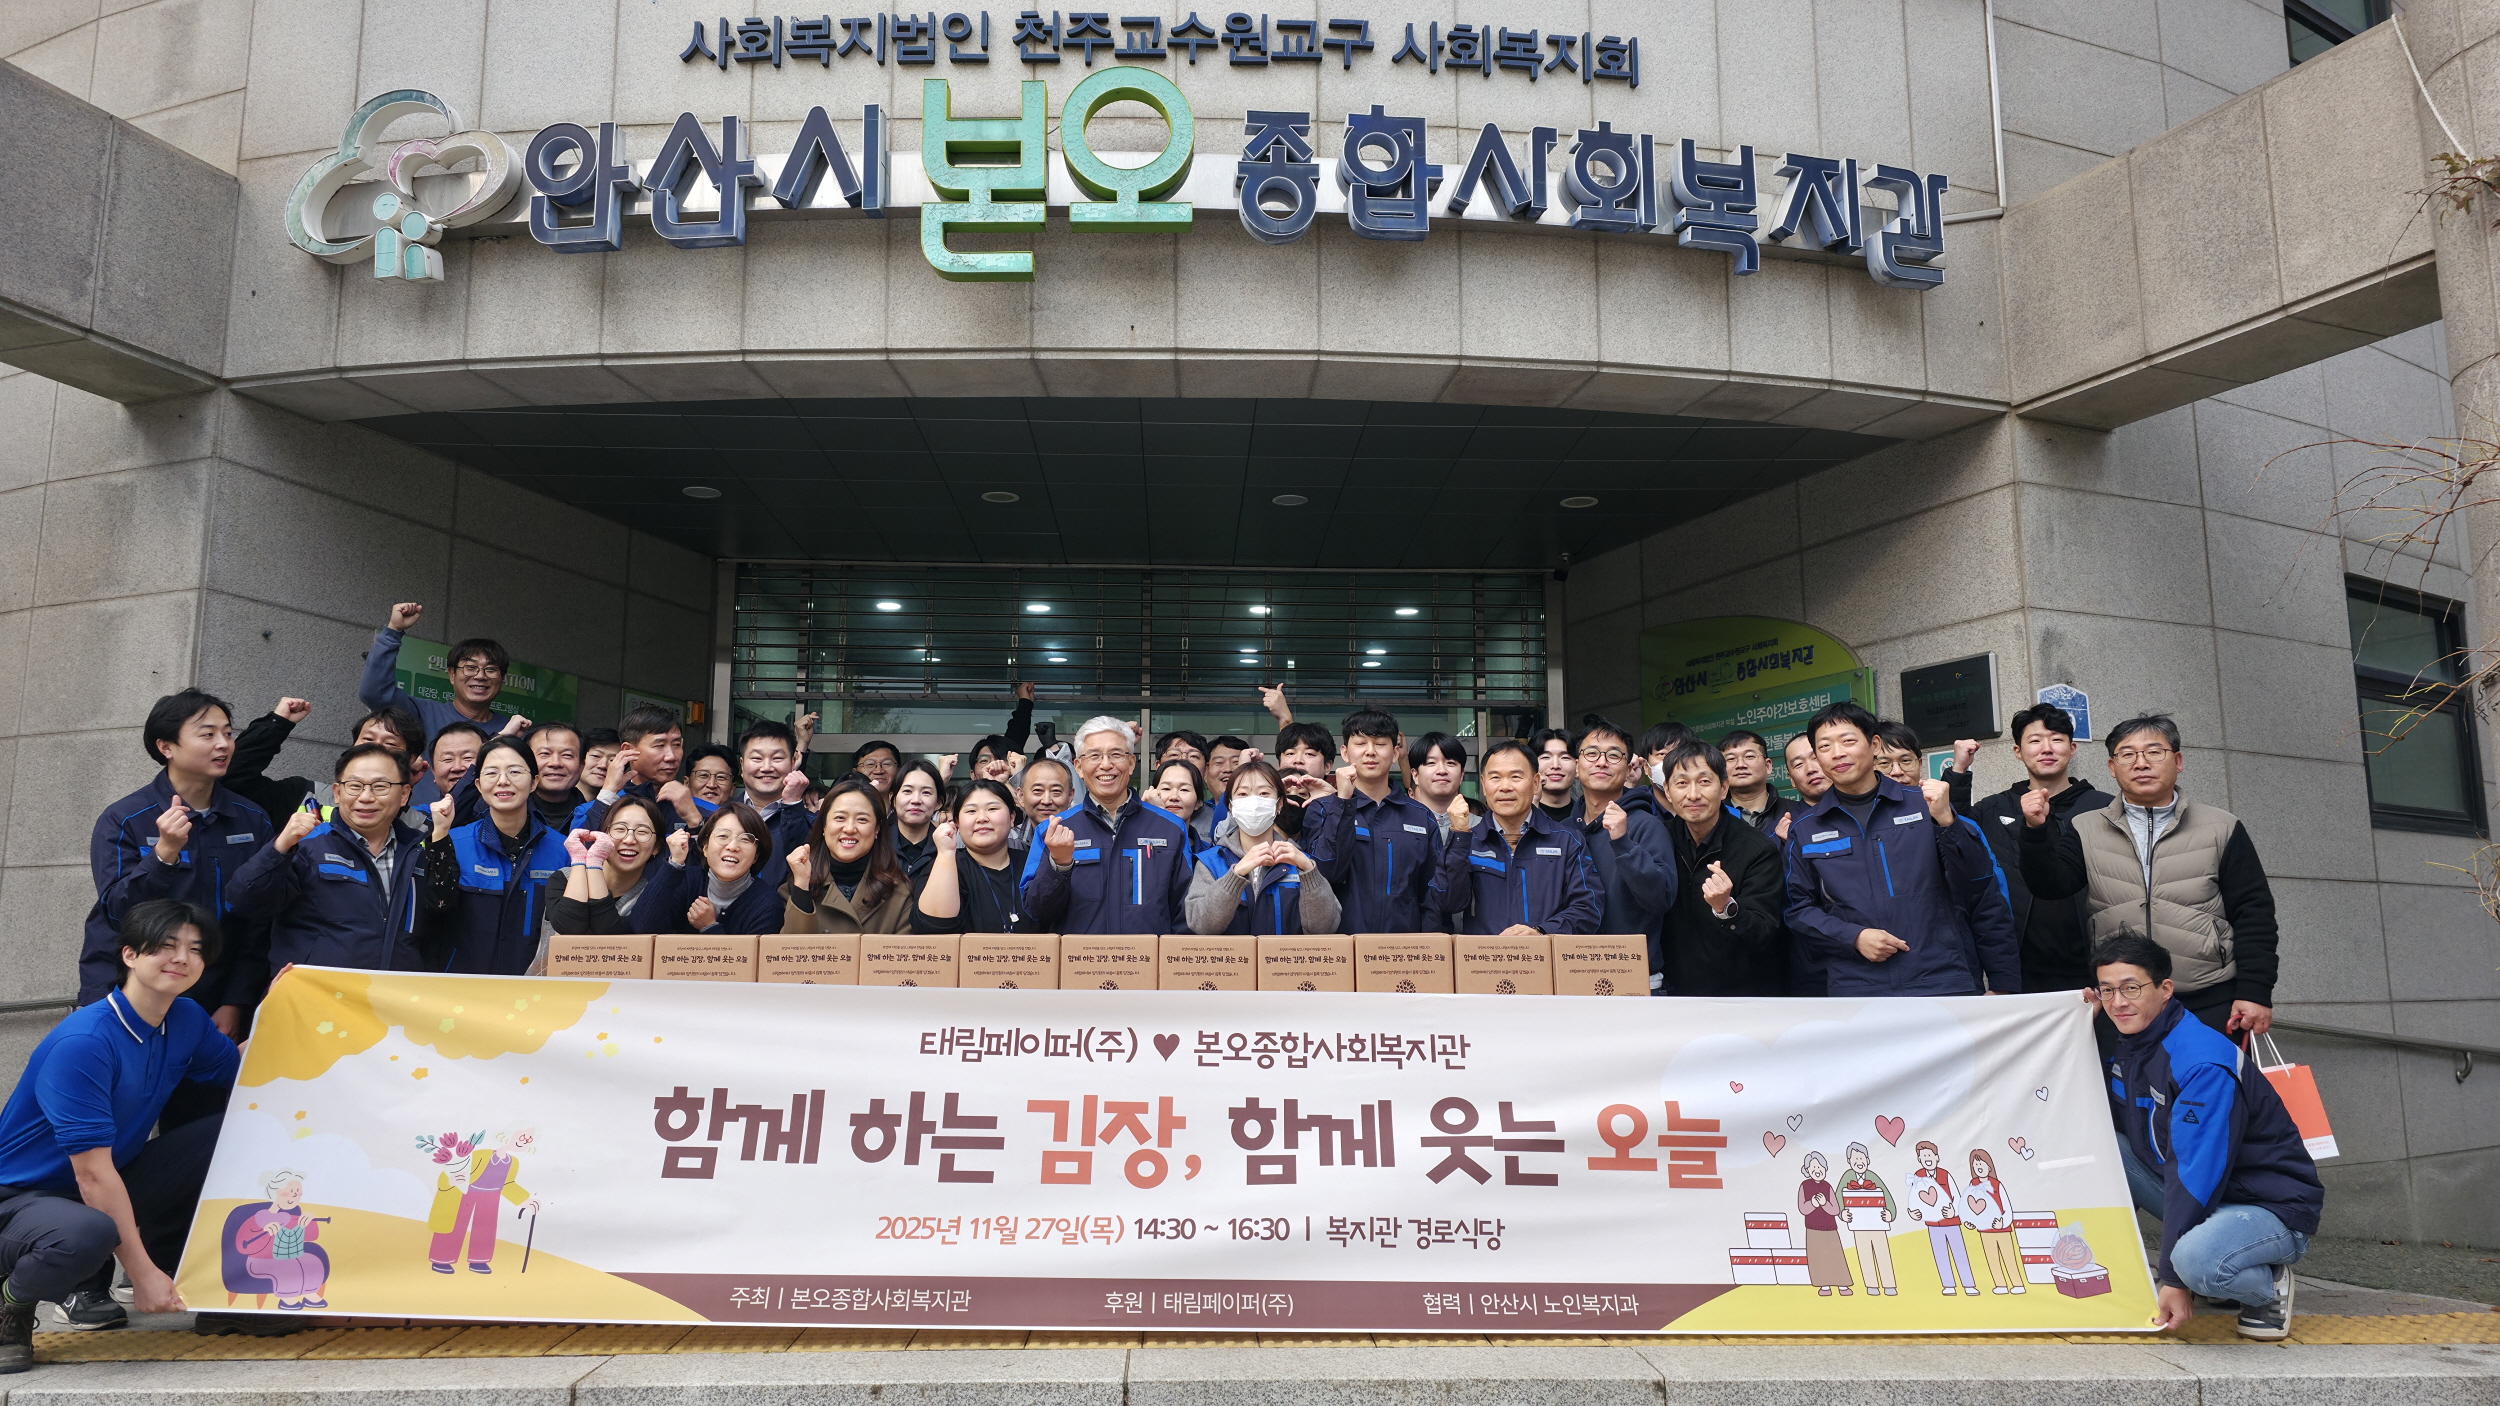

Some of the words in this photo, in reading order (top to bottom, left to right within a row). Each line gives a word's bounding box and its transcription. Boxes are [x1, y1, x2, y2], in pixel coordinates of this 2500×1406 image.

[680, 10, 989, 69] 사회복지법인
[1012, 9, 1375, 71] 천주교수원교구
[1402, 21, 1640, 88] 사회복지회
[524, 103, 890, 253] 안산시
[920, 65, 1195, 282] 본오
[1234, 104, 1950, 290] 종합사회복지관
[503, 673, 536, 691] ATION
[1736, 693, 1831, 726] 노인주야간보호센터
[920, 1027, 1138, 1063] 태림페이퍼(주)
[1194, 1031, 1471, 1070] 본오종합사회복지관
[654, 1086, 825, 1179] 함께
[849, 1091, 1005, 1183] 하는
[1027, 1095, 1201, 1189] 김장,
[1228, 1097, 1395, 1185] 함께
[1420, 1097, 1565, 1186] 웃는
[1588, 1101, 1728, 1189] 오늘
[876, 1216, 961, 1244] 2025년
[970, 1216, 1018, 1244] 11월
[1025, 1215, 1124, 1245] 27일(목)
[1134, 1218, 1196, 1240] 14:30
[1228, 1218, 1290, 1241] 16:30
[1326, 1216, 1402, 1248] 복지관
[1408, 1218, 1505, 1250] 경로식당
[730, 1287, 770, 1309] 주최
[791, 1288, 971, 1312] 본오종합사회복지관
[1104, 1291, 1142, 1313] 후원
[1164, 1292, 1293, 1316] 태림페이퍼(주)
[1423, 1293, 1460, 1314] 협력
[1481, 1293, 1537, 1315] 안산시
[1544, 1294, 1639, 1315] 노인복지과
